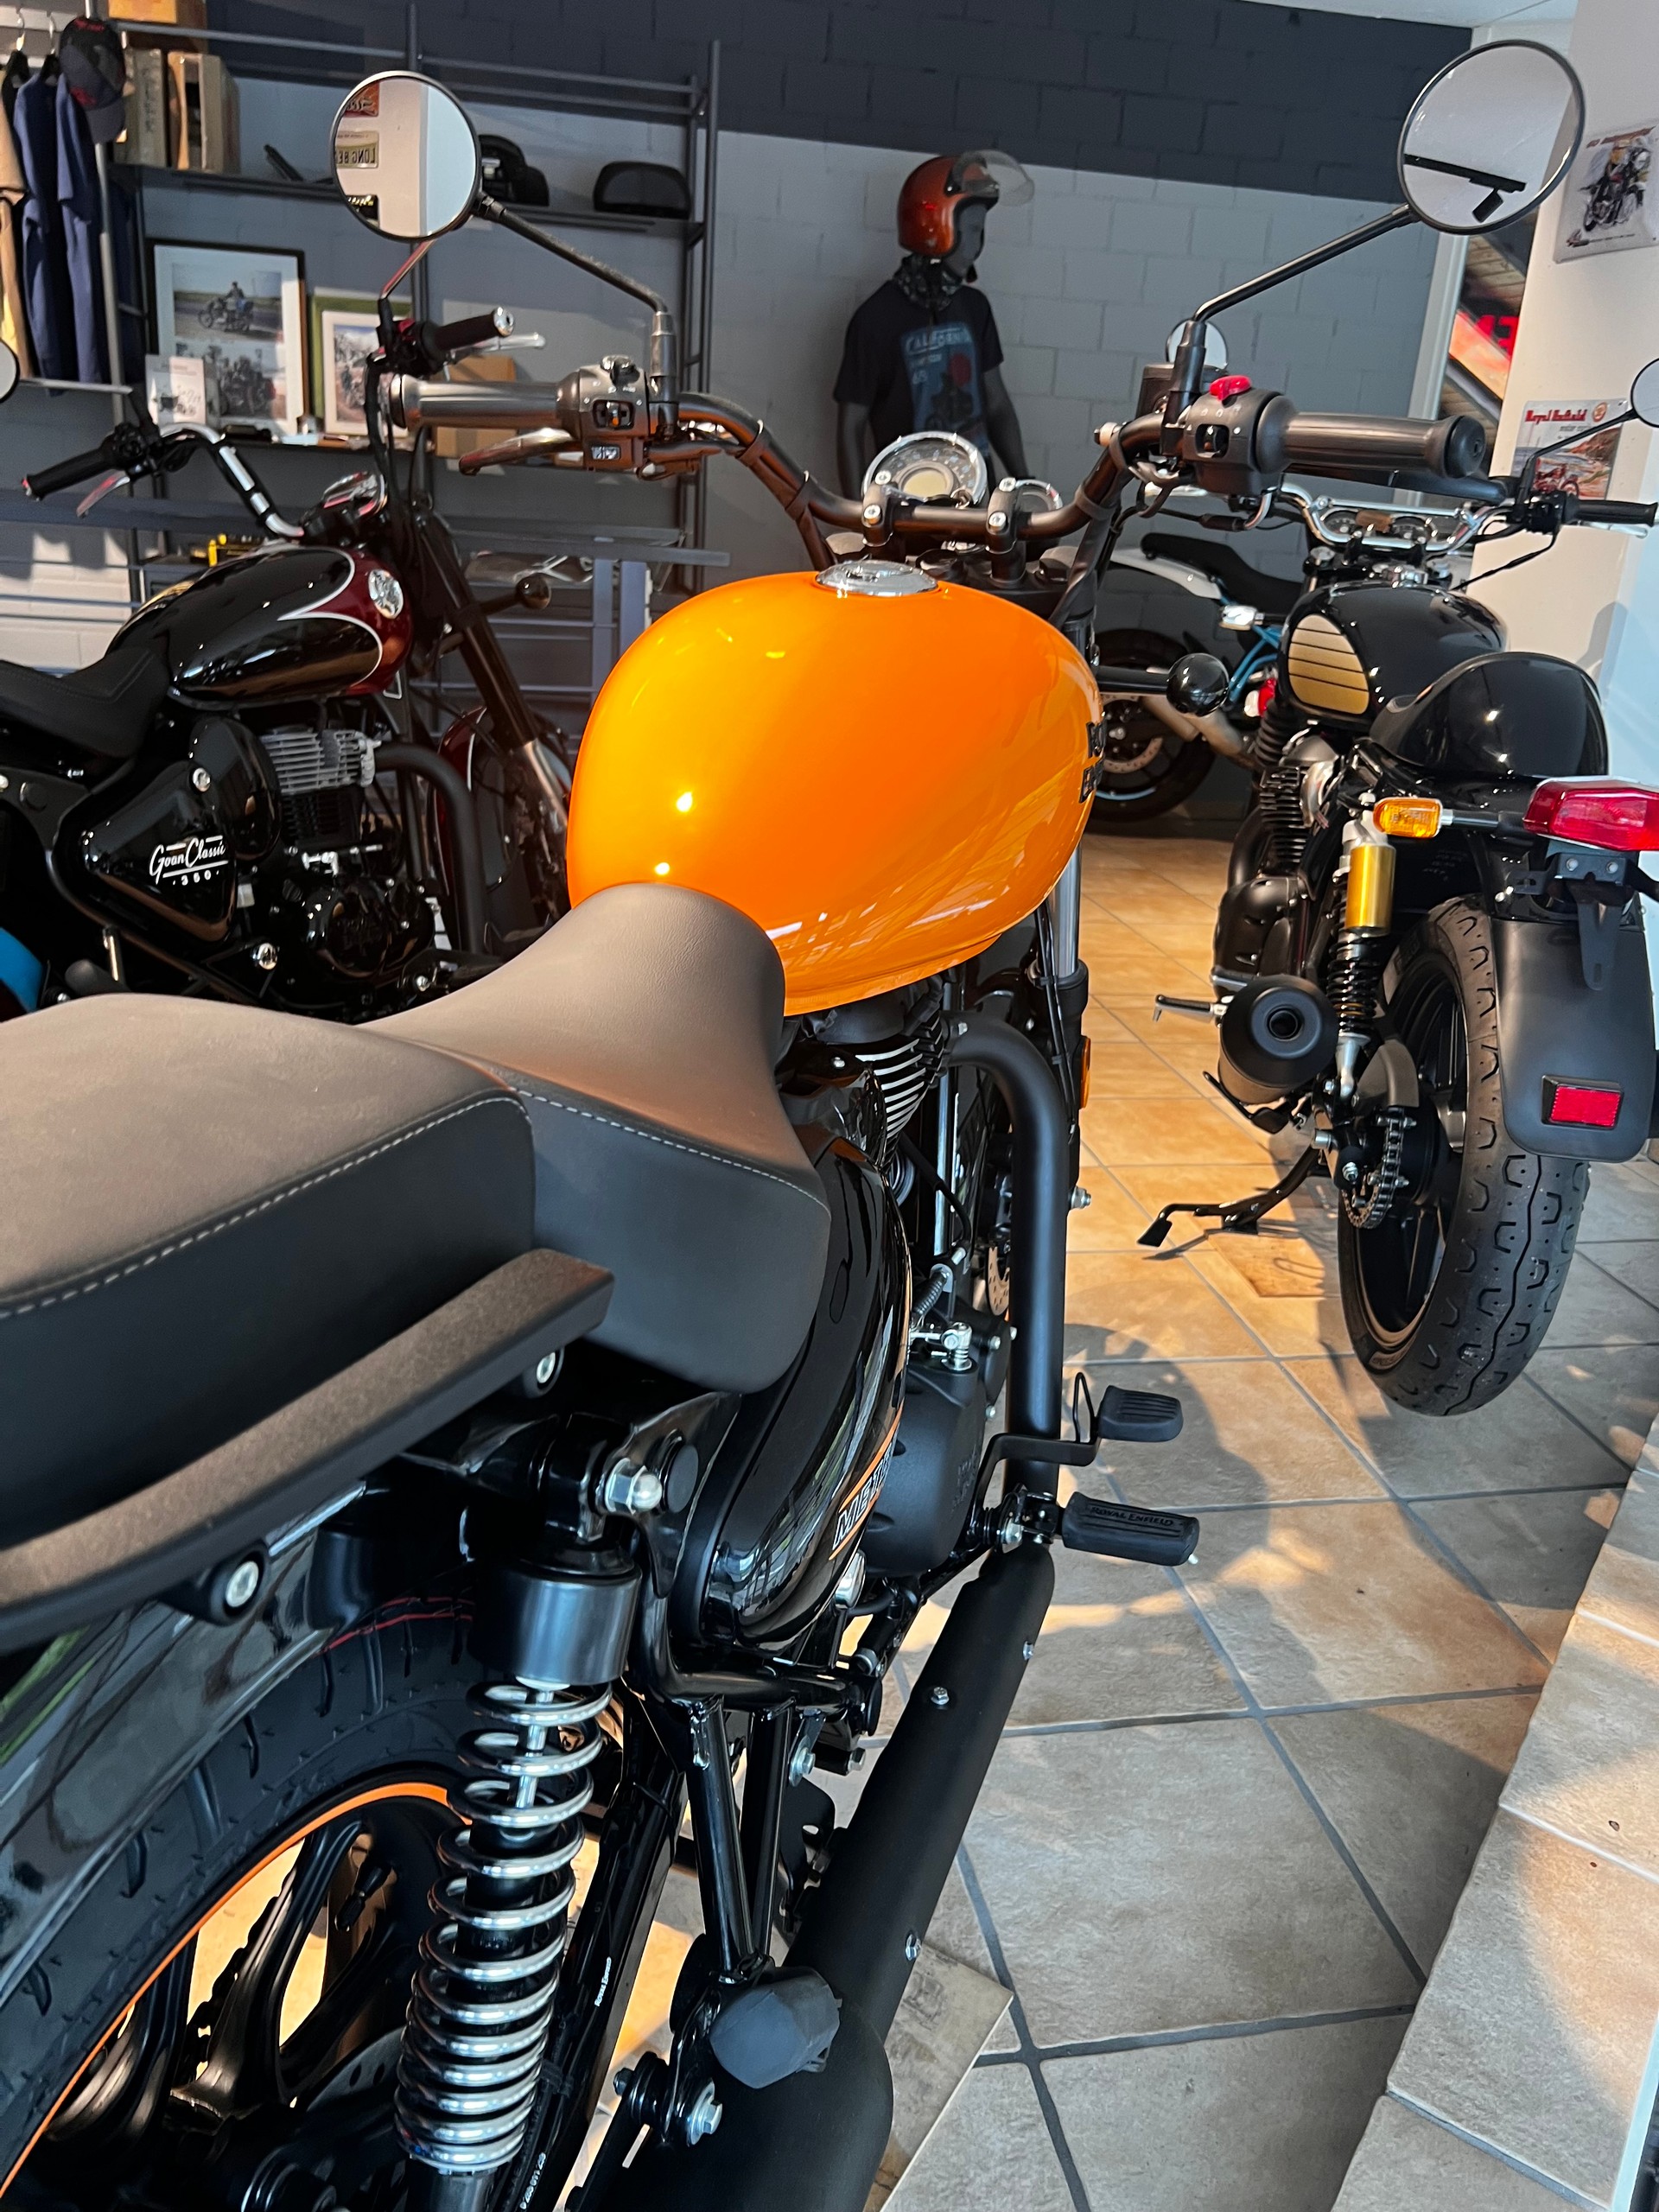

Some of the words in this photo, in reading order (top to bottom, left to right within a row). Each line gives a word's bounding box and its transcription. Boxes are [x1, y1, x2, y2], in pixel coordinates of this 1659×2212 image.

[905, 328, 972, 355] CALFORNIA
[149, 844, 185, 885] Goan
[1091, 1506, 1127, 1519] ROYAL
[1128, 1513, 1174, 1527] ENFIELD
